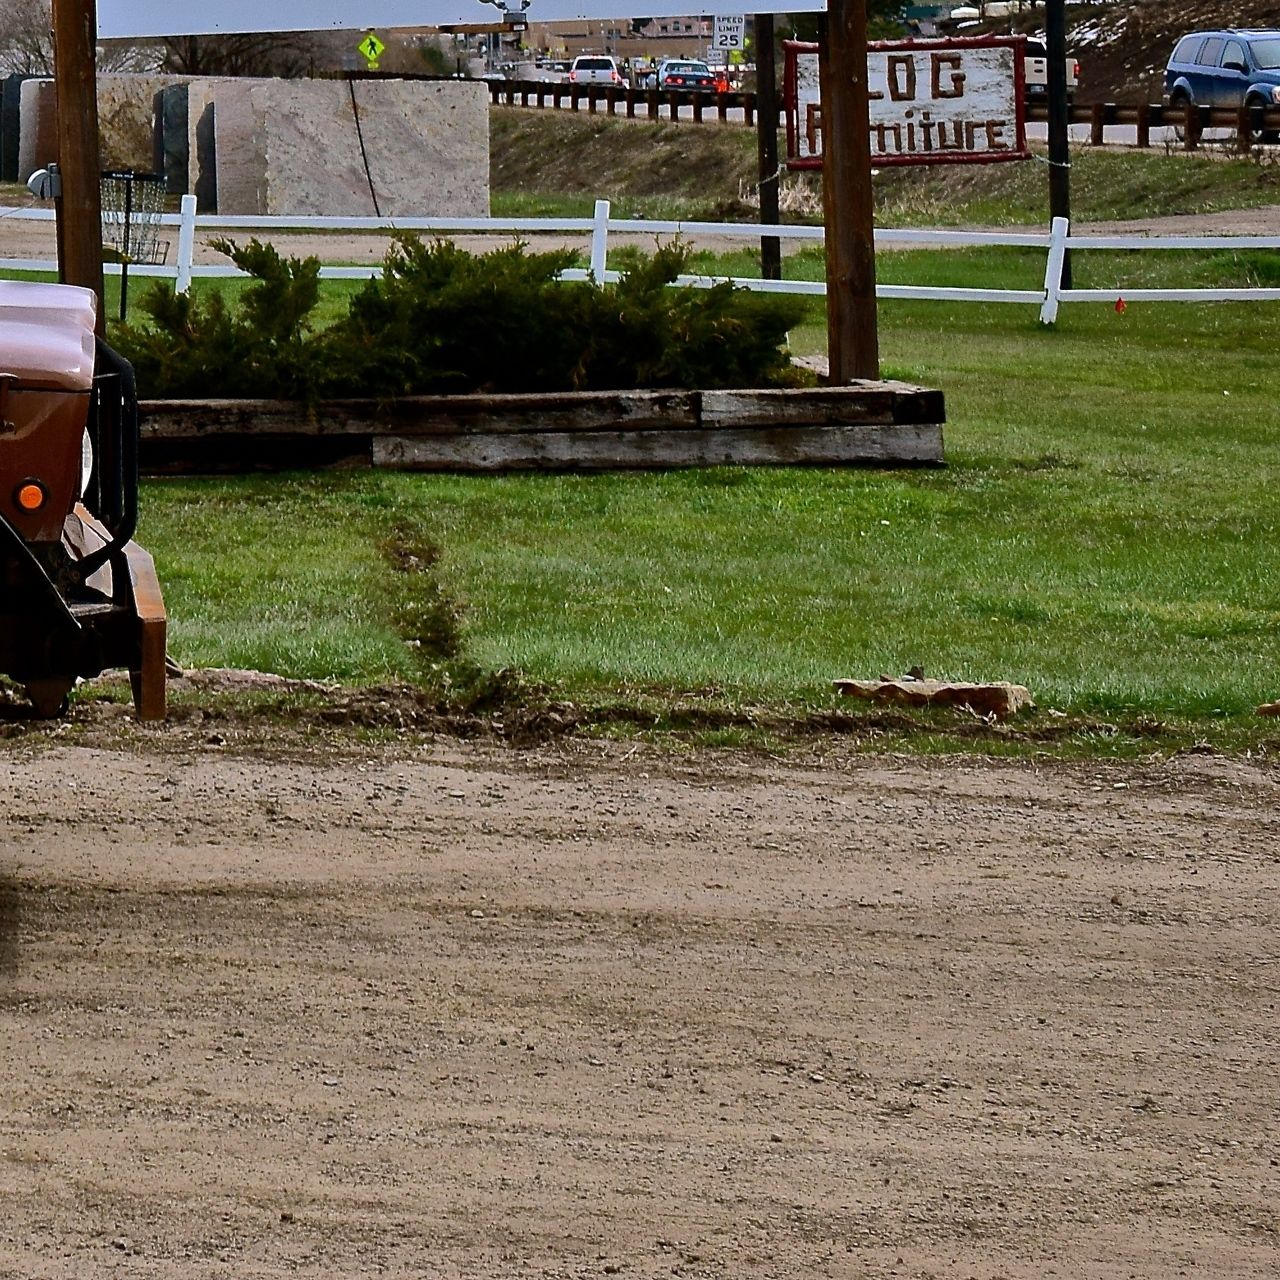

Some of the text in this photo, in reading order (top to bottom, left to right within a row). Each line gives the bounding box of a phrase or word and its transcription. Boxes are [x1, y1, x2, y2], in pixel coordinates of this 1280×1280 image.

[716, 16, 743, 24] SPEED
[719, 34, 739, 46] 25
[868, 52, 966, 102] OG
[806, 104, 1008, 154] Fniture
